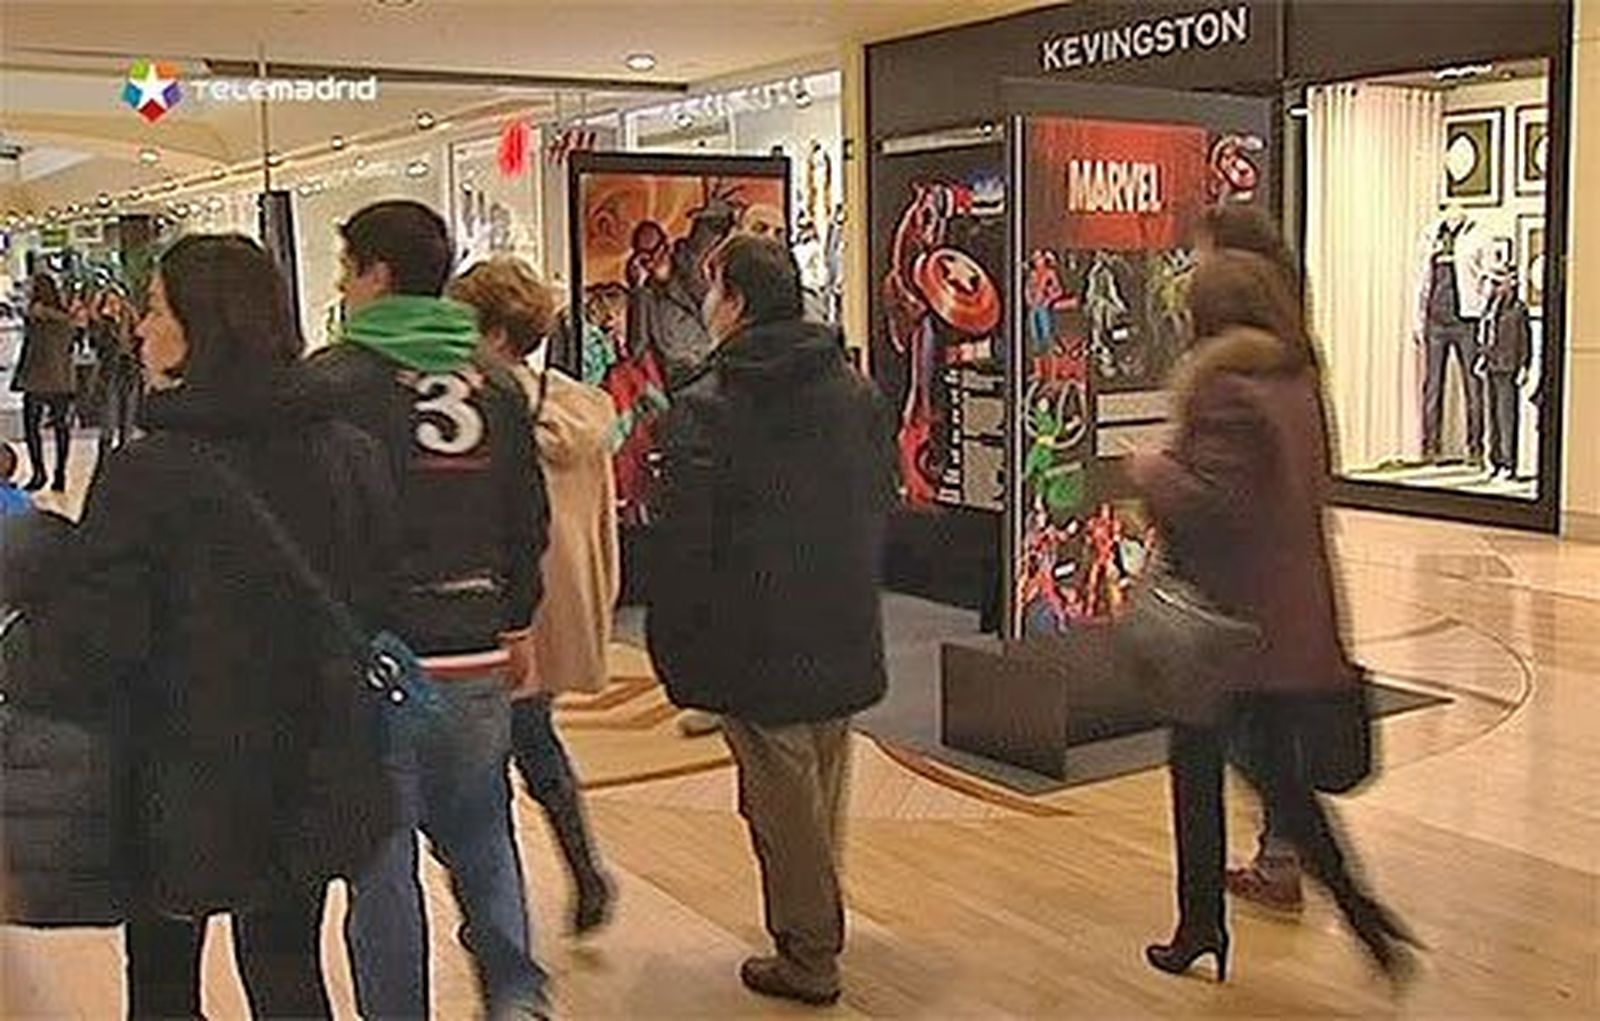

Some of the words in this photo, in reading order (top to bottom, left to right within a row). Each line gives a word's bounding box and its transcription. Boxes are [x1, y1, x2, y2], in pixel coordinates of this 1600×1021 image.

[1043, 7, 1247, 70] KEVINGSTON
[1068, 160, 1161, 212] MARVEL
[414, 374, 484, 454] 3
